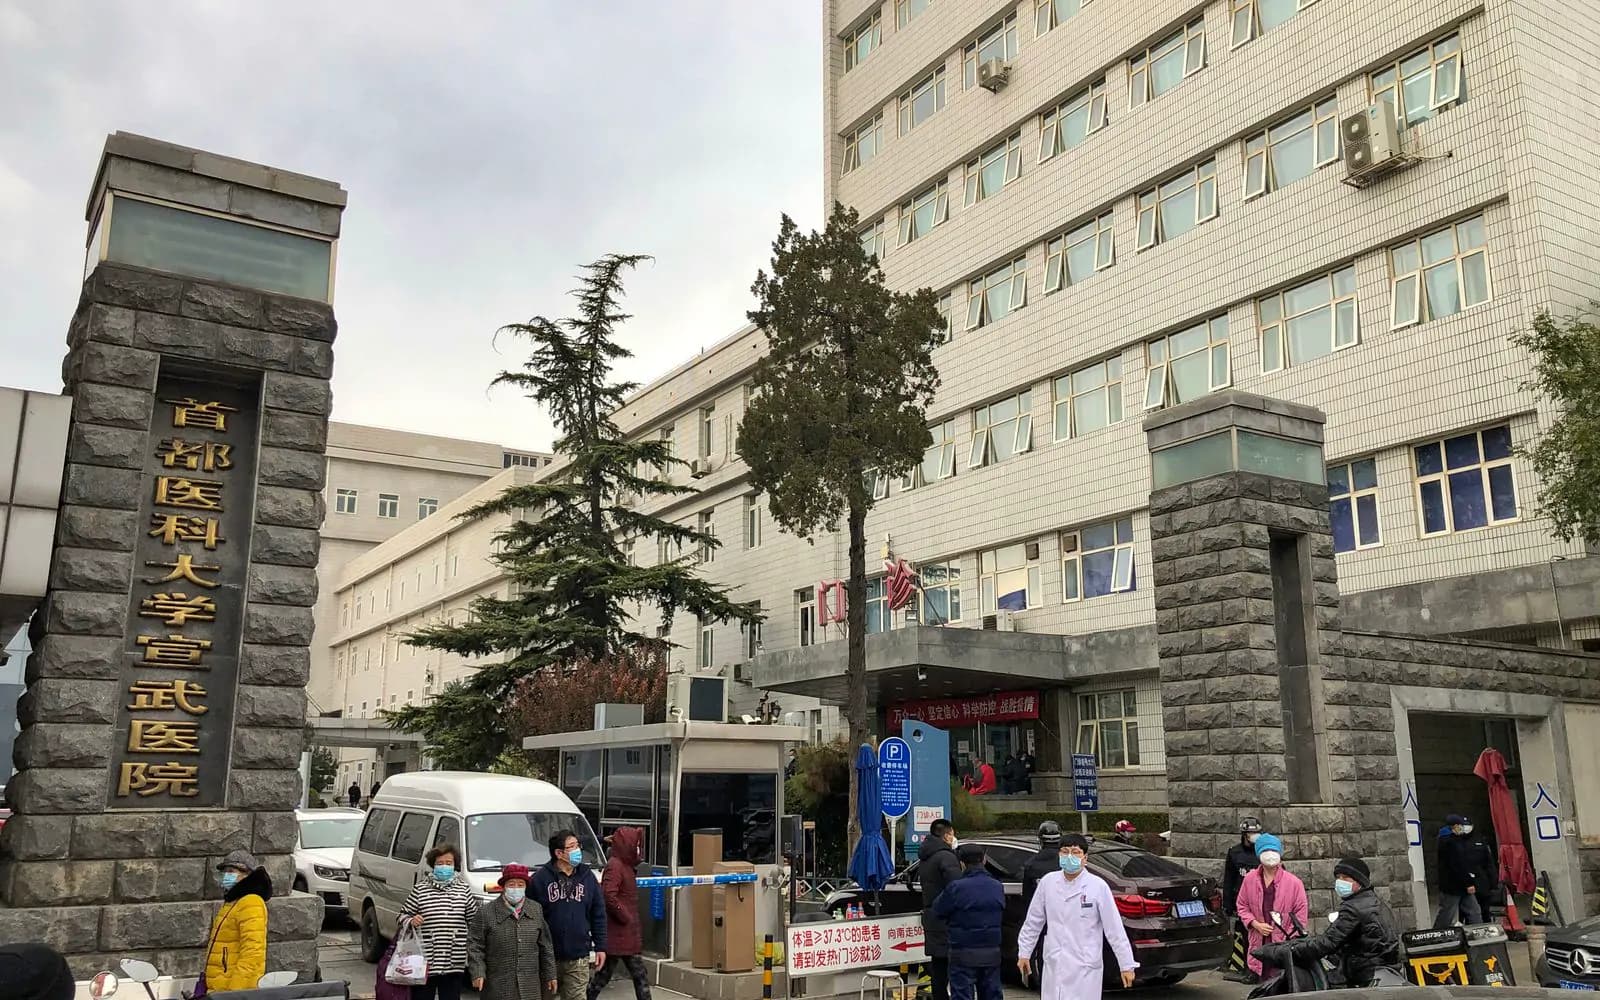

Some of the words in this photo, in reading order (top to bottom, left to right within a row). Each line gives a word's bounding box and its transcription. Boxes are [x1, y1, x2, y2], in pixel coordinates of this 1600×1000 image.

[117, 397, 239, 798] 首都医科大学宣武医院
[927, 704, 960, 721] 坚定信心
[962, 700, 997, 718] 科学防控
[1000, 695, 1035, 714] 战胜疫情
[890, 745, 899, 758] P
[1532, 782, 1561, 840] 入口
[793, 944, 882, 970] 请到发热门诊就诊
